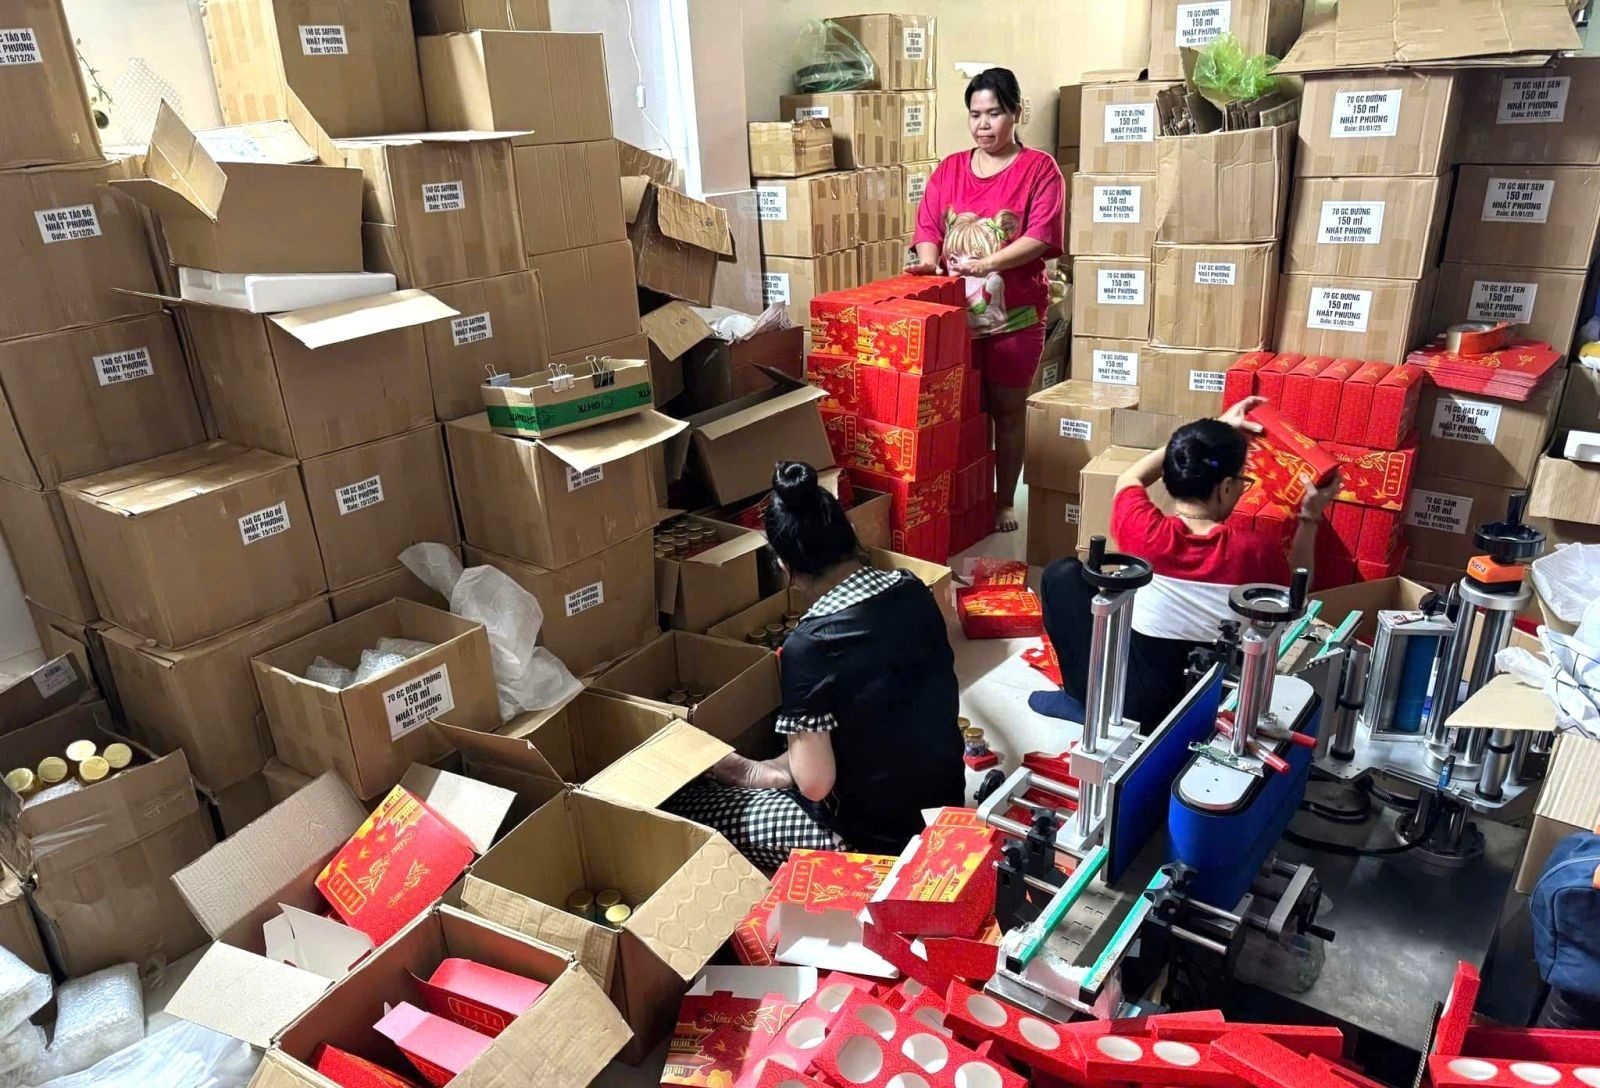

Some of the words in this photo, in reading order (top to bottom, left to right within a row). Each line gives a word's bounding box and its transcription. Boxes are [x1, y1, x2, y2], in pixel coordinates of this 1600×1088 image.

[1192, 18, 1203, 27] 150
[1205, 17, 1213, 26] ml
[4, 31, 20, 42] TÁO
[20, 29, 32, 41] ĐỎ
[6, 54, 36, 63] 15/12/24
[1513, 81, 1521, 90] 70
[1522, 81, 1532, 89] GC
[1532, 81, 1546, 90] HẠT
[1547, 80, 1560, 88] SEN
[1347, 96, 1354, 104] 70
[1521, 90, 1536, 100] 150
[1538, 90, 1549, 100] ml
[1353, 105, 1367, 114] 150
[1368, 104, 1379, 113] ml
[1132, 117, 1139, 125] ml
[1498, 182, 1506, 190] 70
[1517, 183, 1529, 192] HẠT
[1506, 191, 1520, 200] 150
[1522, 192, 1533, 201] ml
[43, 212, 56, 222] 140
[57, 211, 68, 220] GC
[70, 210, 80, 219] TÁO
[82, 206, 92, 218] ĐỎ
[1338, 216, 1351, 225] 150
[1353, 216, 1363, 225] ml
[52, 232, 68, 240] Date:
[70, 229, 95, 238] 15/12/24
[1481, 284, 1489, 292] 70
[1490, 284, 1498, 292] GC
[1499, 285, 1512, 294] HẠT
[1513, 286, 1525, 294] SEN
[1489, 293, 1503, 302] 150
[1504, 294, 1514, 303] ml
[1328, 301, 1341, 309] 150
[1342, 302, 1352, 310] ml
[100, 357, 113, 366] 140
[114, 356, 122, 364] GC
[124, 353, 136, 362] TÁO
[137, 350, 146, 360] ĐỎ
[107, 374, 122, 382] Date:
[1444, 405, 1451, 413] 70
[1452, 414, 1465, 423] 150
[1467, 415, 1478, 425] ml
[1427, 504, 1441, 513] 150
[1442, 506, 1452, 515] ml
[242, 516, 253, 527] 140
[253, 514, 262, 524] GC
[248, 532, 261, 541] Date:
[387, 694, 396, 703] 70
[397, 689, 405, 699] GC
[404, 692, 418, 706] 150
[420, 687, 430, 700] ml
[402, 716, 416, 729] Date:
